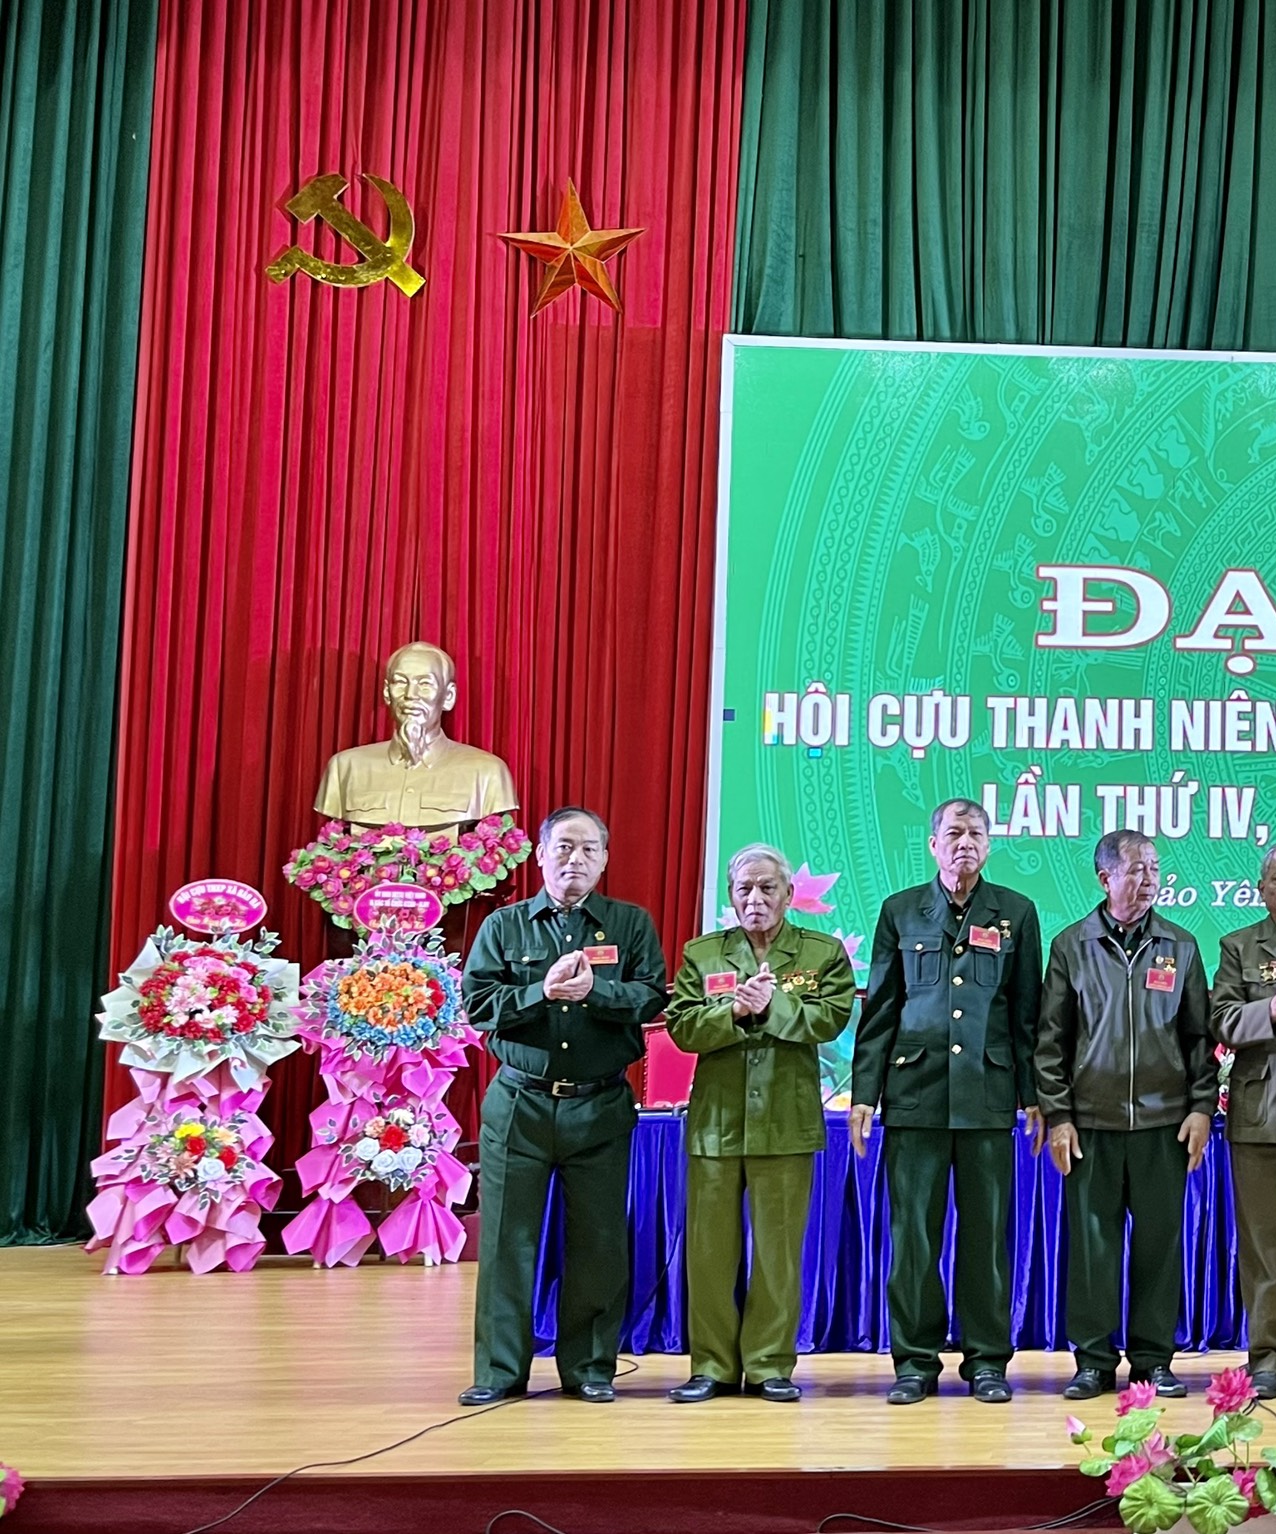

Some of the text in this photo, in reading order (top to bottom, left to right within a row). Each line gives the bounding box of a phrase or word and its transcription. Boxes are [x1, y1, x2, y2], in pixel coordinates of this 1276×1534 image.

[763, 682, 850, 759] HỘI
[867, 690, 971, 759] CỰU
[986, 696, 1154, 751] THANH
[981, 766, 1081, 837] LẦN
[1096, 771, 1199, 838] THỨ
[1208, 786, 1269, 847] IV,
[1152, 873, 1198, 907] ảo
